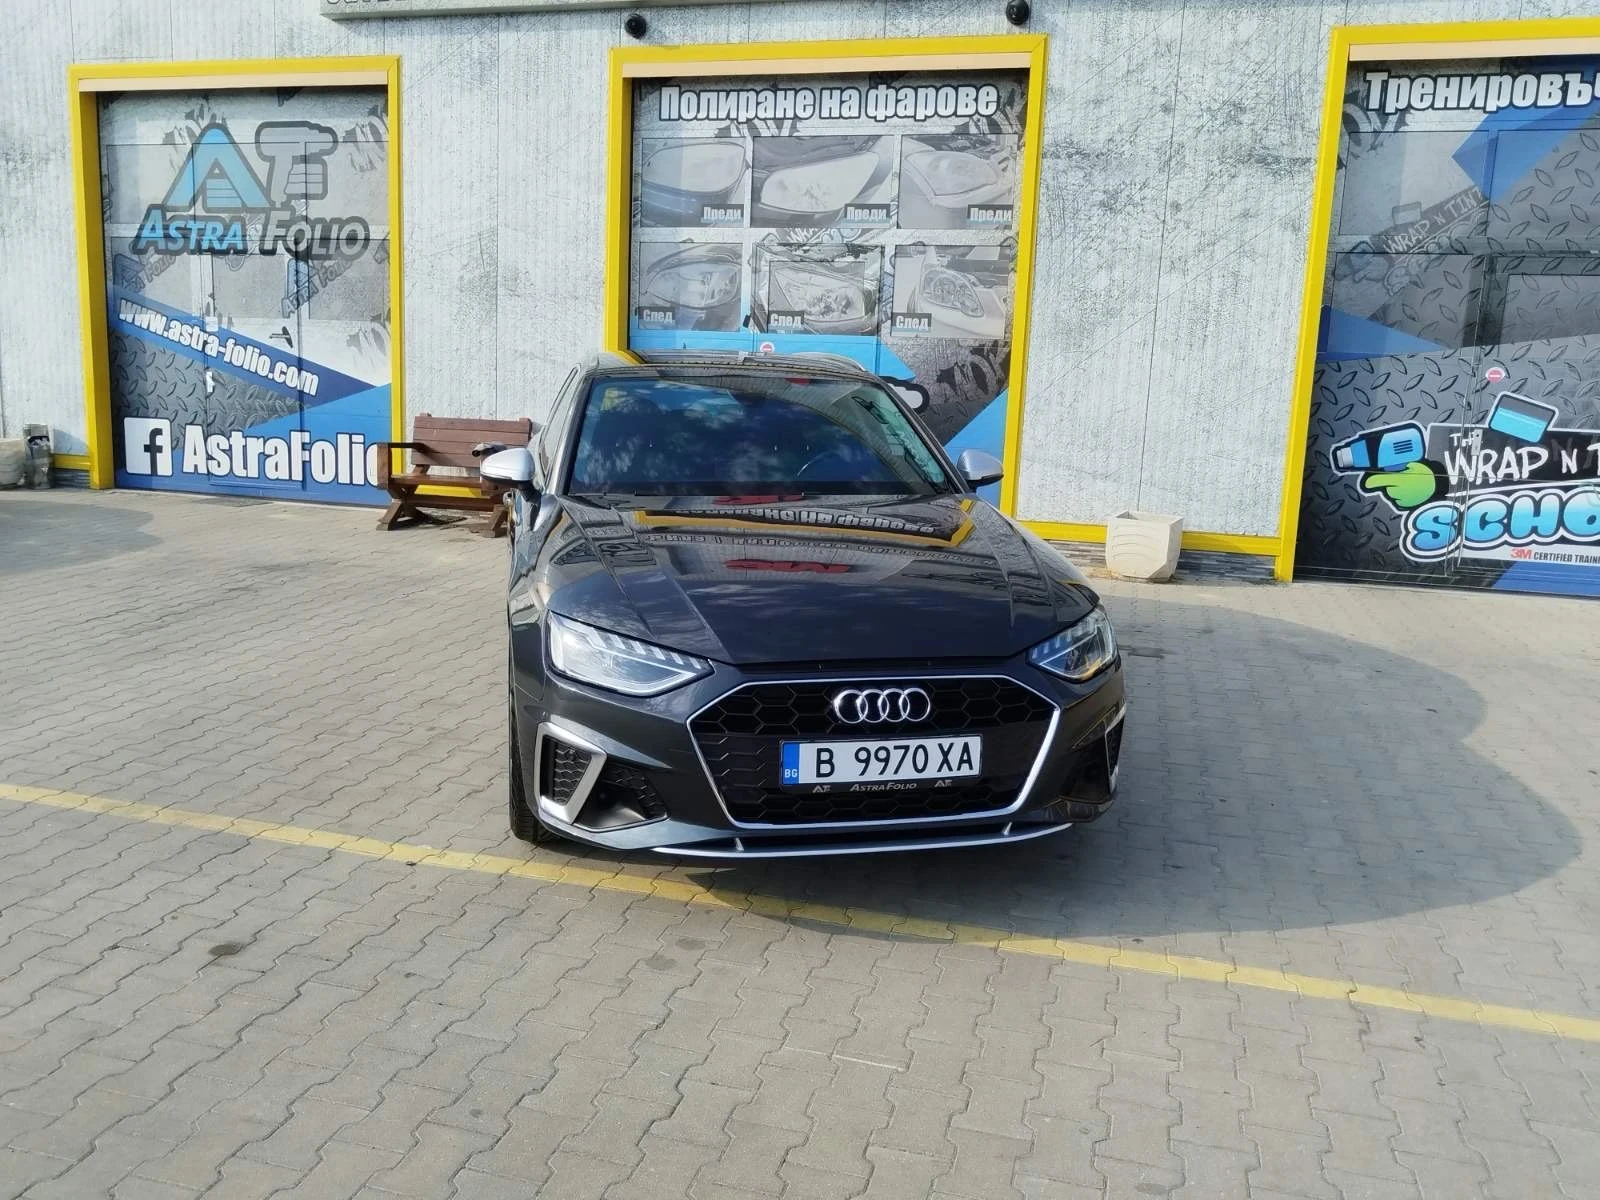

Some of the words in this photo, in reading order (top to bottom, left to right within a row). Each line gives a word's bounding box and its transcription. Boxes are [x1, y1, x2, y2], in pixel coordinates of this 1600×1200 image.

[1364, 71, 1600, 113] Тренировъ
[661, 85, 814, 123] Полиране
[820, 88, 861, 118] на
[866, 83, 998, 121] фарове
[703, 206, 741, 220] Преди
[846, 206, 887, 221] Преди
[970, 207, 1012, 222] Преди
[134, 205, 246, 252] ASTRA
[260, 208, 369, 256] FOLIO
[1383, 219, 1431, 254] WRAP
[643, 309, 673, 324] След
[770, 313, 801, 329] След
[896, 315, 929, 332] След
[118, 297, 320, 397] www.astra-folio.com
[1444, 446, 1549, 485] WRAP
[1561, 448, 1578, 474] N
[1511, 548, 1532, 560] 3M
[1533, 551, 1573, 562] CERTIFIED
[816, 747, 835, 778] B
[854, 744, 929, 776] 9970
[937, 742, 973, 773] XA
[784, 768, 798, 779] BG
